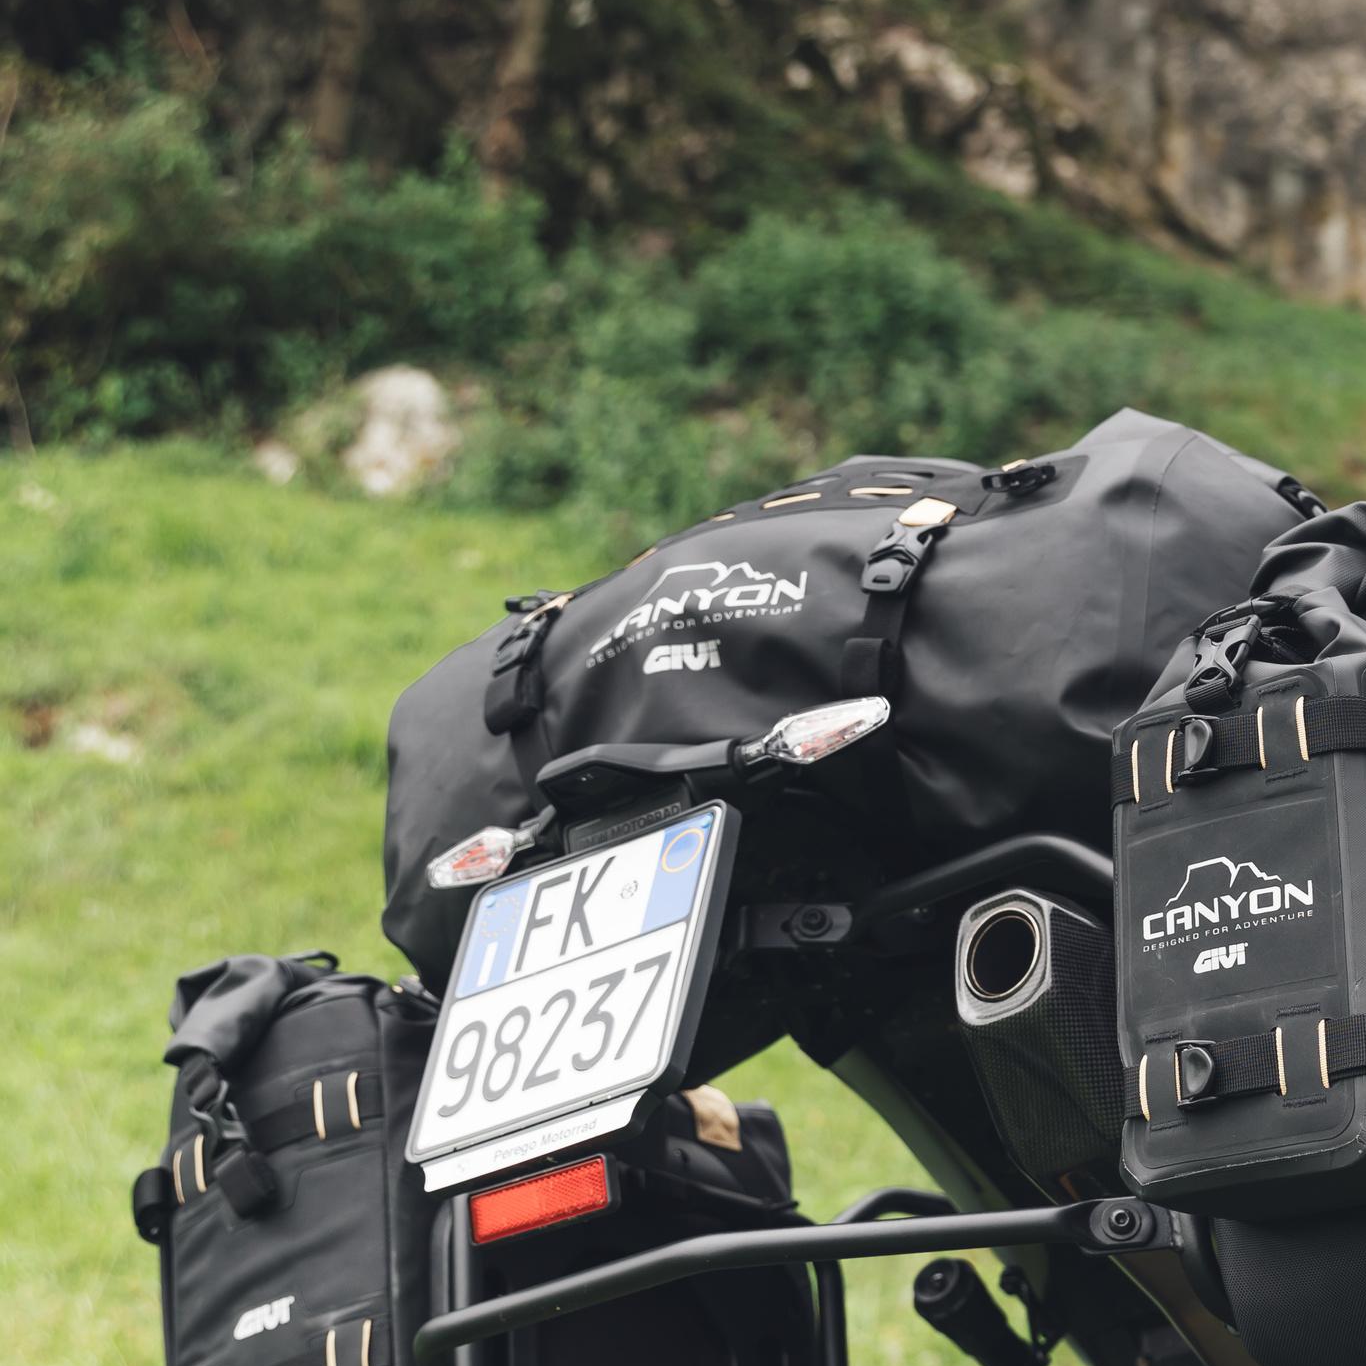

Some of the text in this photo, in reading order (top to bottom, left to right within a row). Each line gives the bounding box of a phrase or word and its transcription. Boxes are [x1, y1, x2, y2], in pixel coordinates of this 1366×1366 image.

[661, 618, 697, 631] FOR
[702, 603, 803, 625] ADVENTURE
[643, 640, 722, 675] GIVI
[610, 804, 681, 838] MOTORRAD
[514, 855, 617, 973] FK
[1142, 879, 1314, 941] CANYON
[1142, 910, 1314, 953] DESIGNED FOR ADVENTURE
[1193, 942, 1249, 975] GIVI
[437, 951, 673, 1118] 98237
[493, 1119, 598, 1163] Perego Motorrad
[233, 1295, 295, 1341] GIVI
